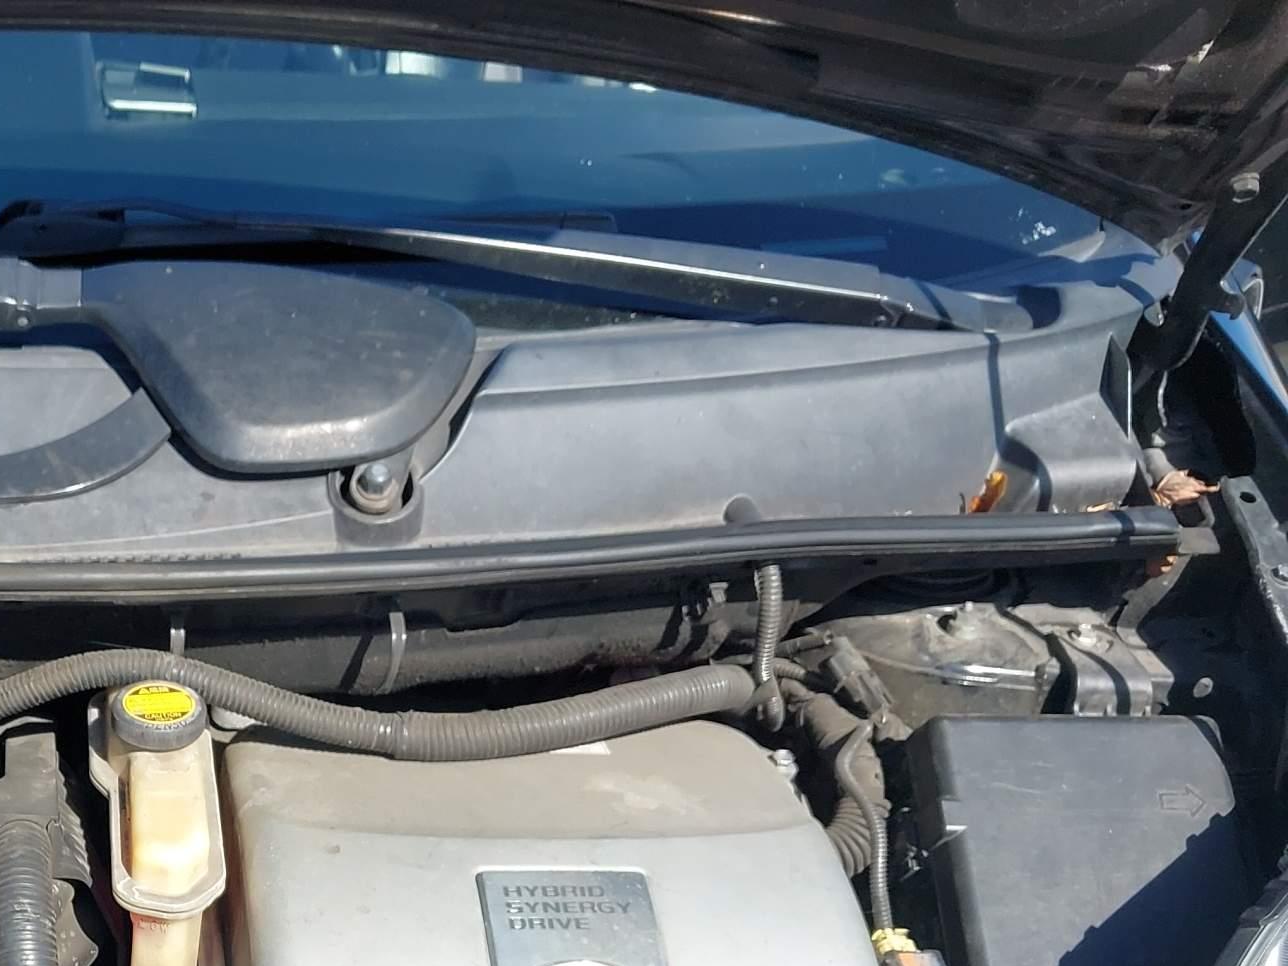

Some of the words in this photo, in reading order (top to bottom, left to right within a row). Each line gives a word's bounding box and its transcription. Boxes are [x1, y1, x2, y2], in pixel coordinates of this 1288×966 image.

[144, 711, 182, 720] CAUTION
[502, 884, 605, 898] HYBRID
[505, 901, 632, 914] SYNERGY
[509, 917, 592, 931] DRIVE
